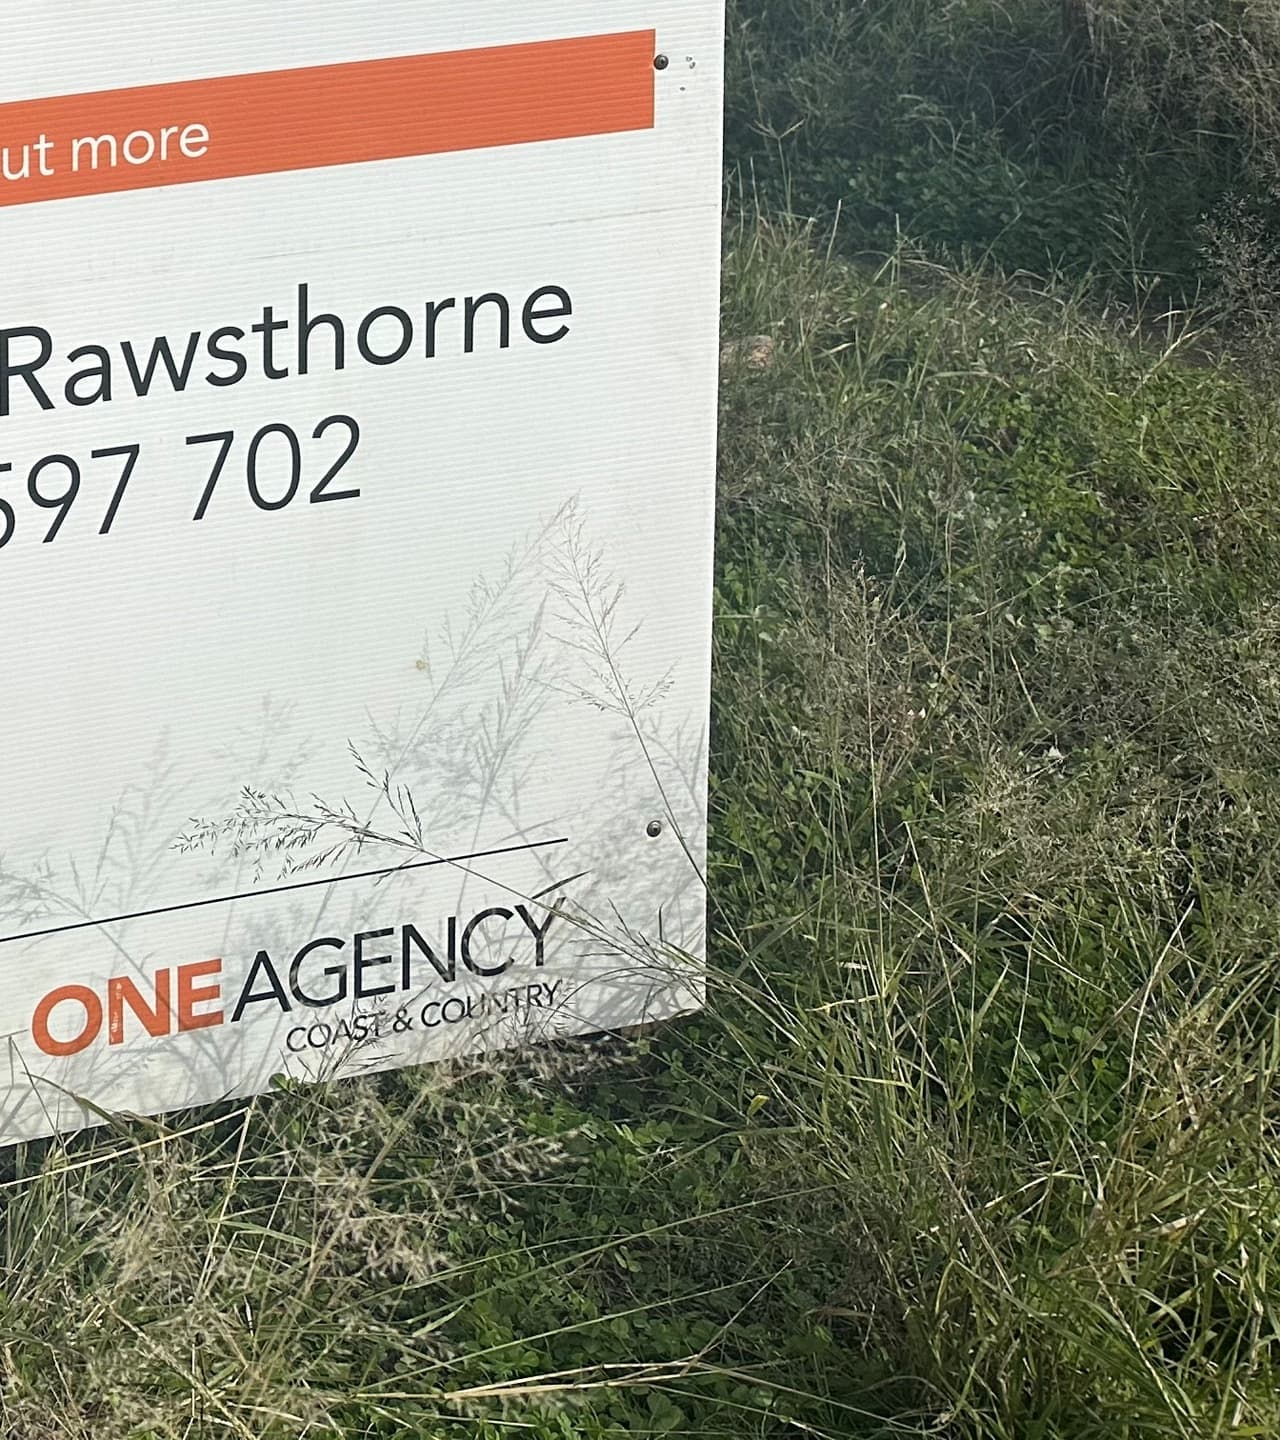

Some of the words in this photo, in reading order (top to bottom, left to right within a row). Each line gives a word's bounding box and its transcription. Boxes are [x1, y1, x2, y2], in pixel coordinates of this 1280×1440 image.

[72, 123, 209, 172] more
[185, 414, 361, 521] 702
[286, 1011, 387, 1053] COAST
[392, 1005, 414, 1034] &
